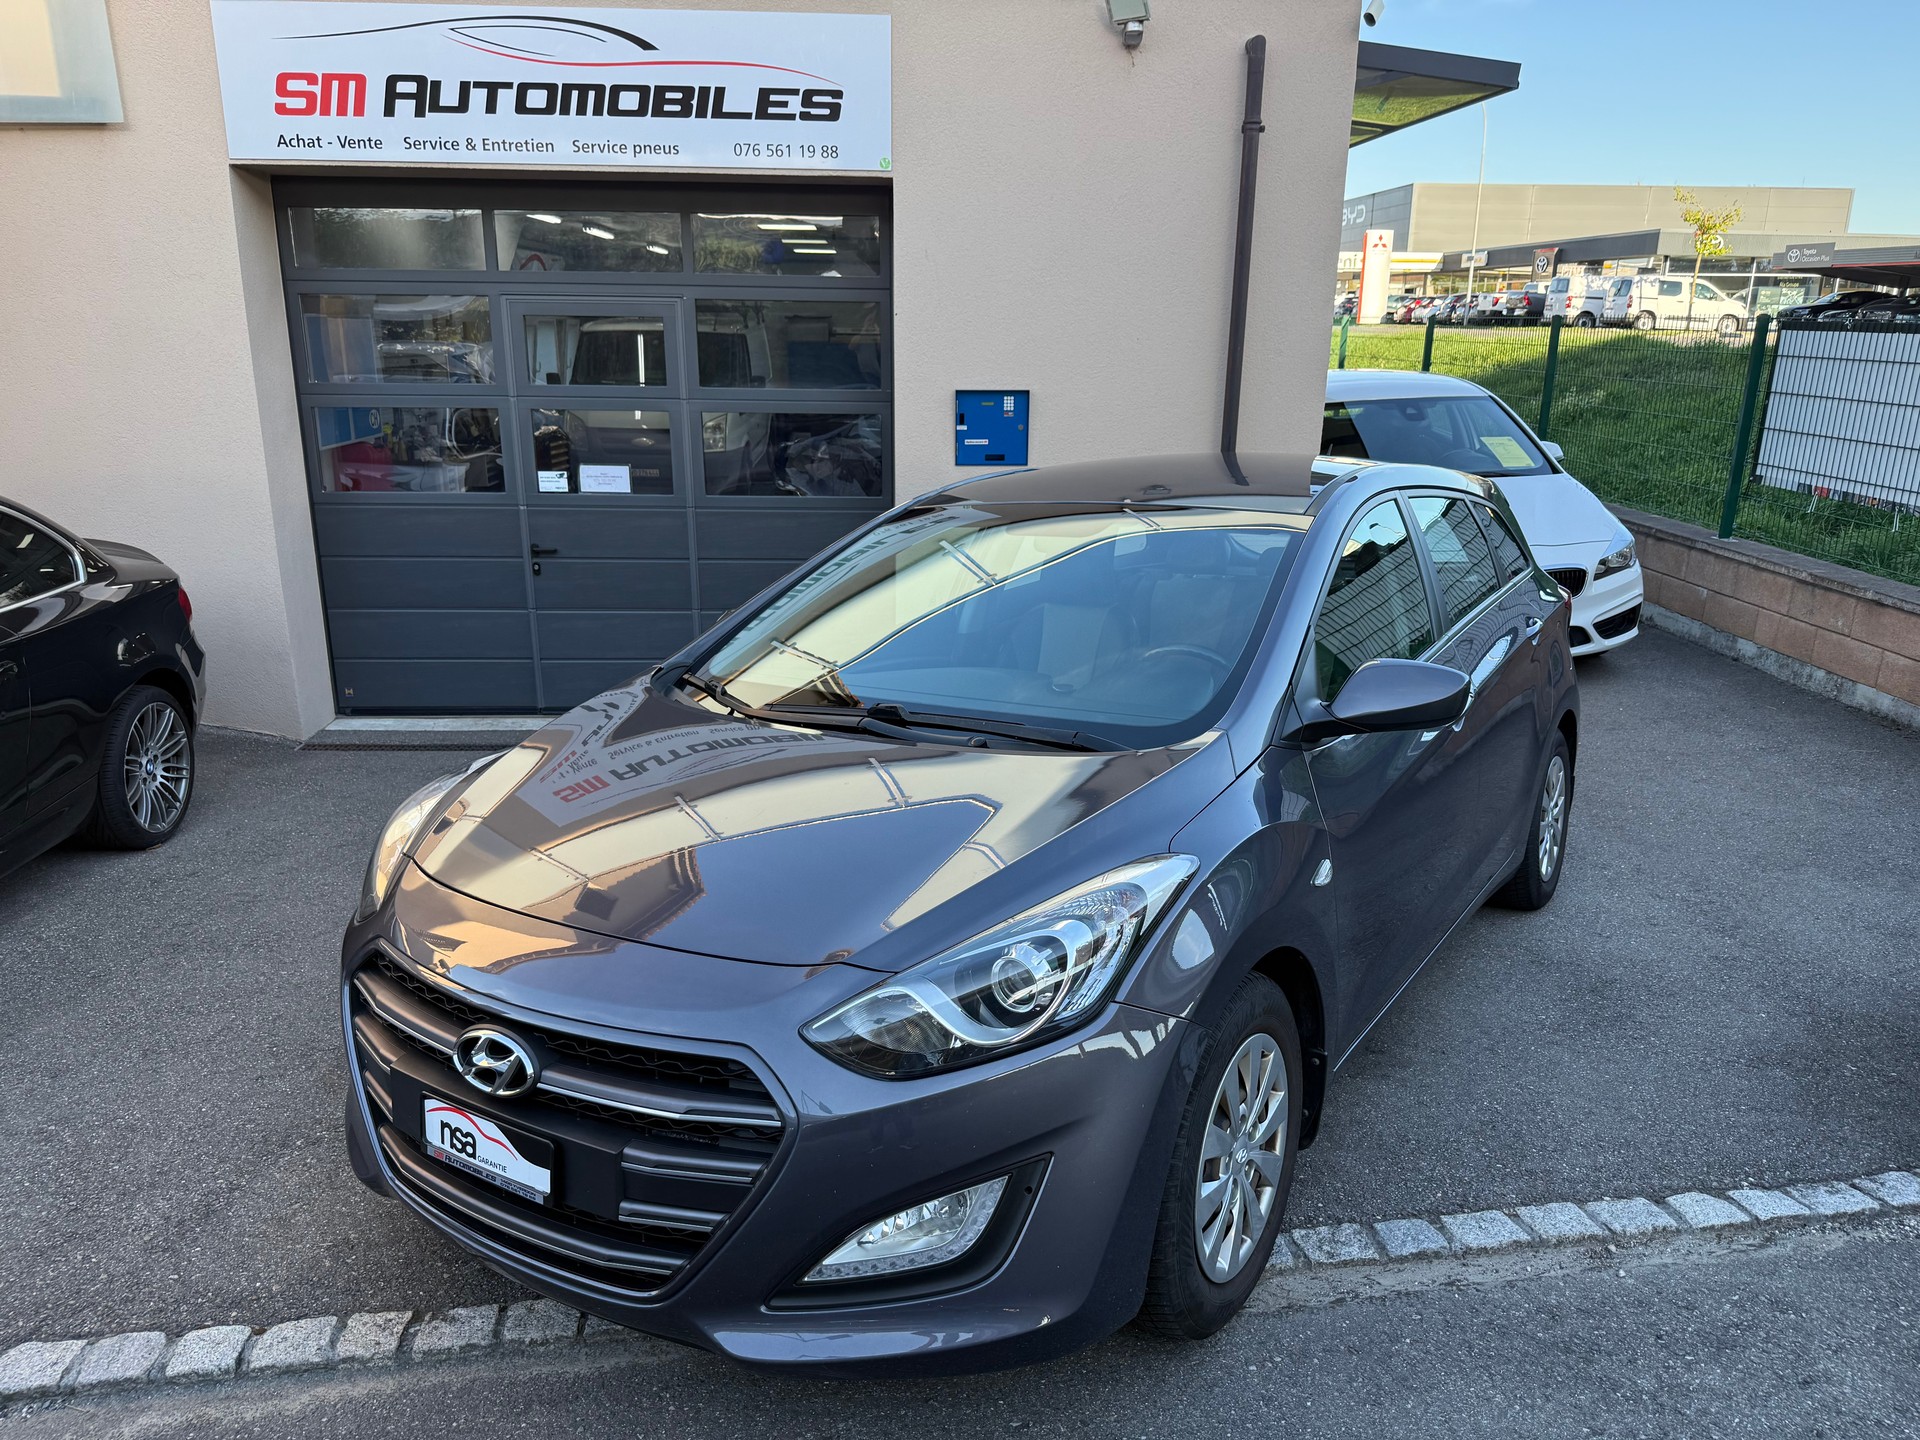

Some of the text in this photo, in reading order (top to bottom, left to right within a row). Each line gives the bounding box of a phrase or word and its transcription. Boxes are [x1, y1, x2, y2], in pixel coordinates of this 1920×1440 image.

[274, 72, 844, 122] SM AUTOMOBILES
[277, 134, 322, 149] Achat
[337, 135, 383, 149] Vente
[403, 136, 554, 153] Service & Entretien
[572, 139, 679, 158] Service pneus
[733, 143, 839, 159] 076 561 19 88
[1803, 248, 1816, 256] Toyota
[1821, 254, 1830, 262] Plus
[441, 1120, 477, 1160] nsa
[444, 1154, 497, 1183] AUTOMOBILES
[477, 1155, 508, 1174] GARANTIE
